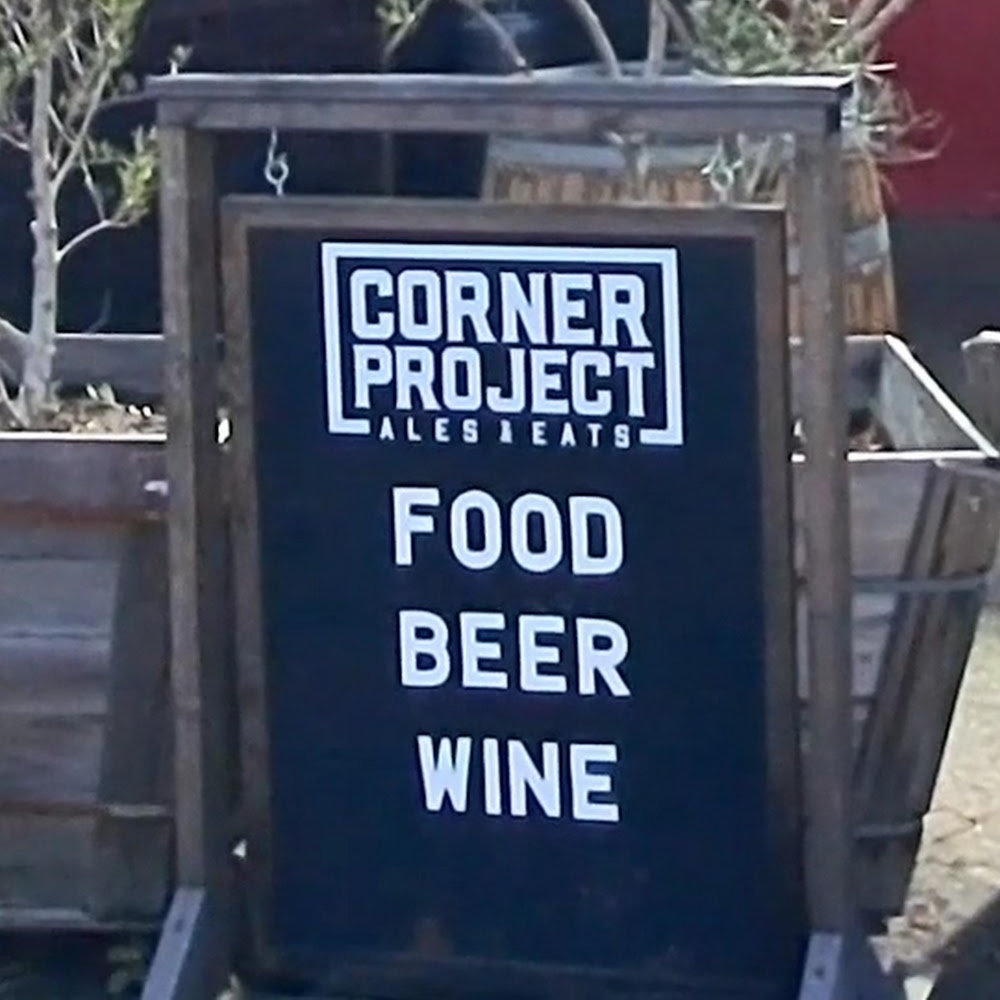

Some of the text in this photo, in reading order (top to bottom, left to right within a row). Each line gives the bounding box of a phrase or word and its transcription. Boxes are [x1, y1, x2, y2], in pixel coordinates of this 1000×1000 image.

[350, 268, 653, 347] CORNER
[352, 344, 655, 418] PROJECT
[379, 416, 478, 443] ALES
[532, 421, 630, 449] EATS
[393, 487, 623, 575] FOOD
[399, 610, 631, 697] BEER
[418, 735, 619, 822] WINE
